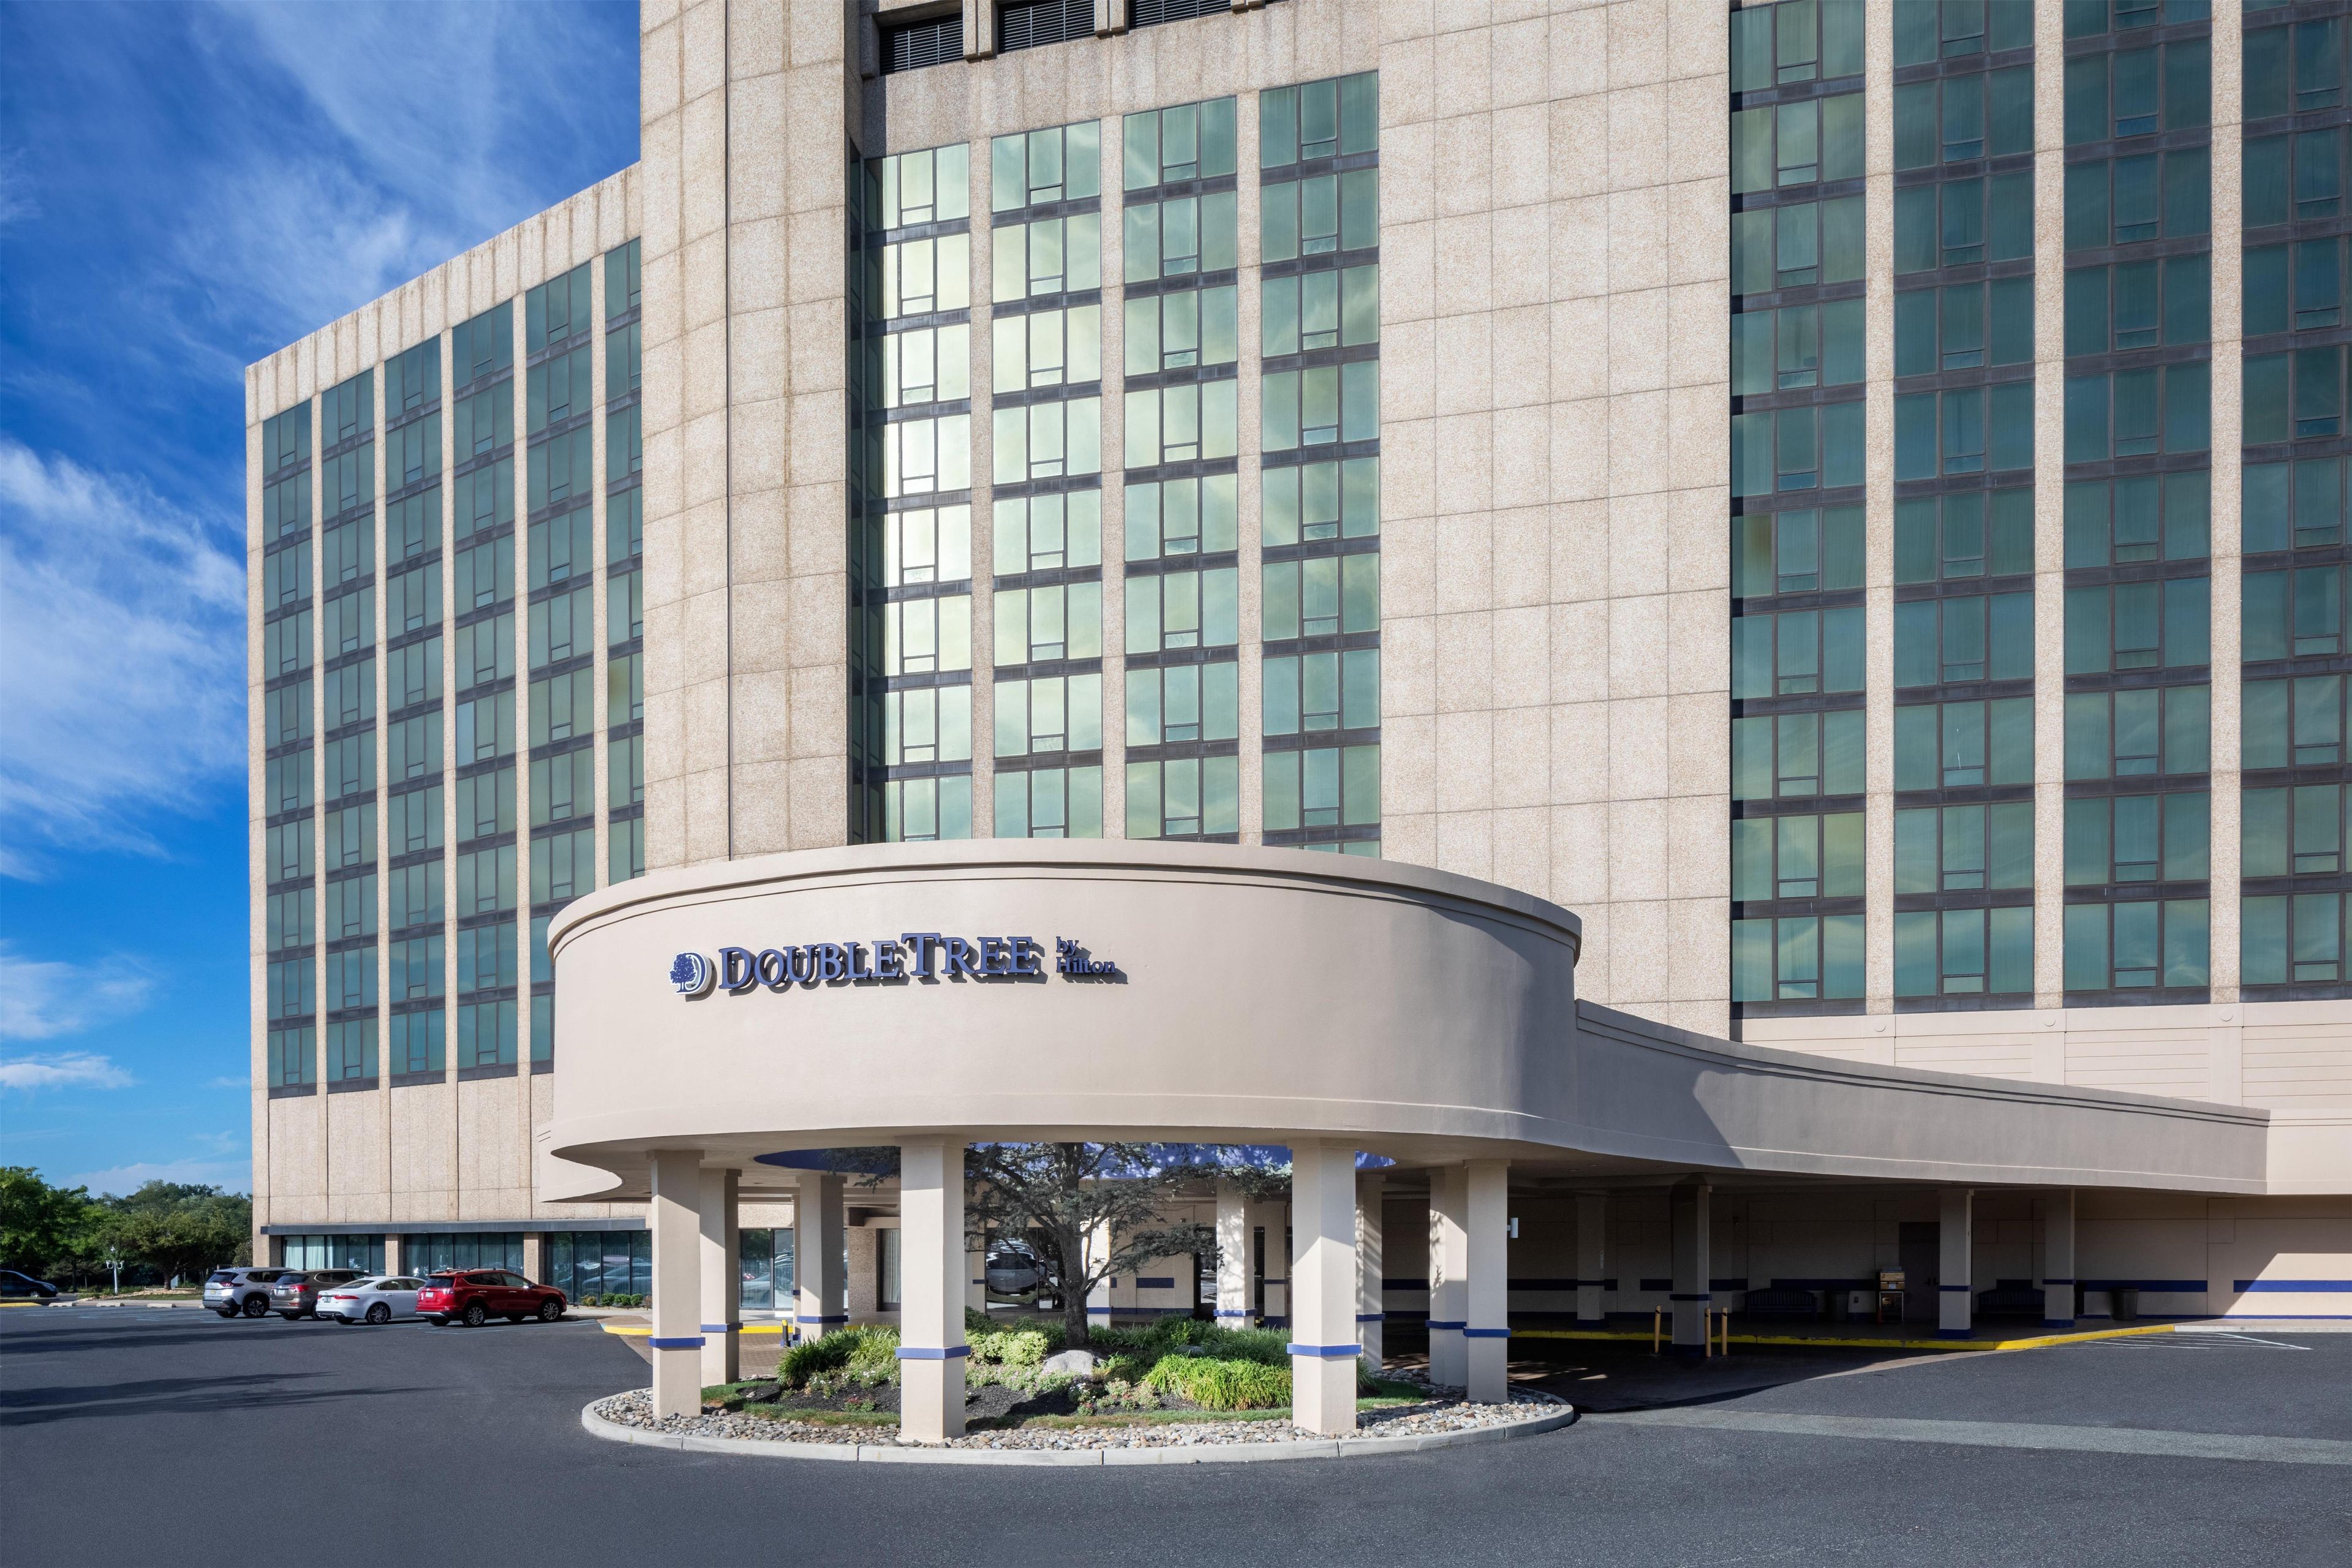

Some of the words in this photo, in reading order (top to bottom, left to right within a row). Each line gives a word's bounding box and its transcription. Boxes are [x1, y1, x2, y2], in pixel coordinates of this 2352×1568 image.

[1056, 937, 1079, 956] by
[718, 932, 1035, 990] DOUBLETREE
[1056, 957, 1115, 973] Hilton
